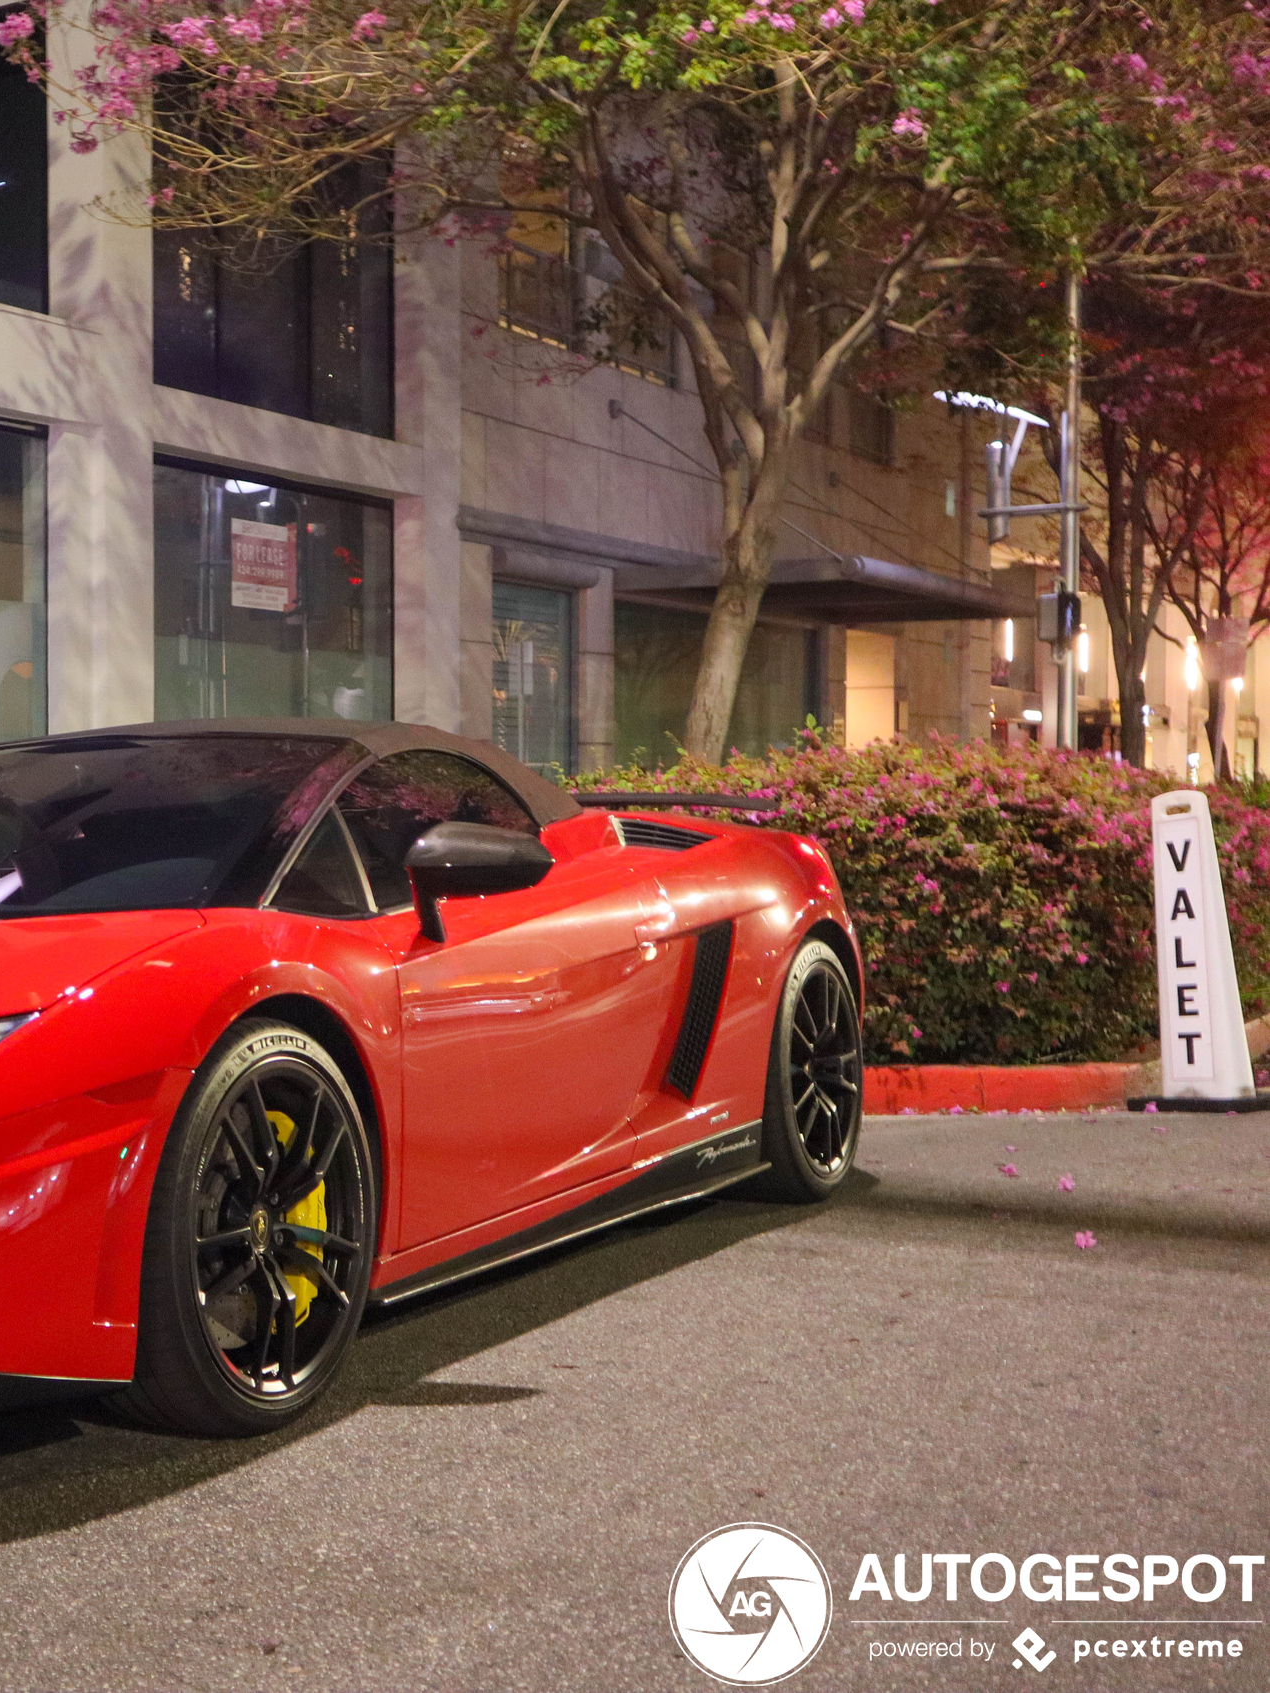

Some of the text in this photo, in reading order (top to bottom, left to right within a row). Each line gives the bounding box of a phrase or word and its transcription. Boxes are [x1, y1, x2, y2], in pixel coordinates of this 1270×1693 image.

[236, 544, 284, 565] FOR LEASE
[1166, 839, 1202, 1065] VALET
[252, 1036, 305, 1053] MICHELIN
